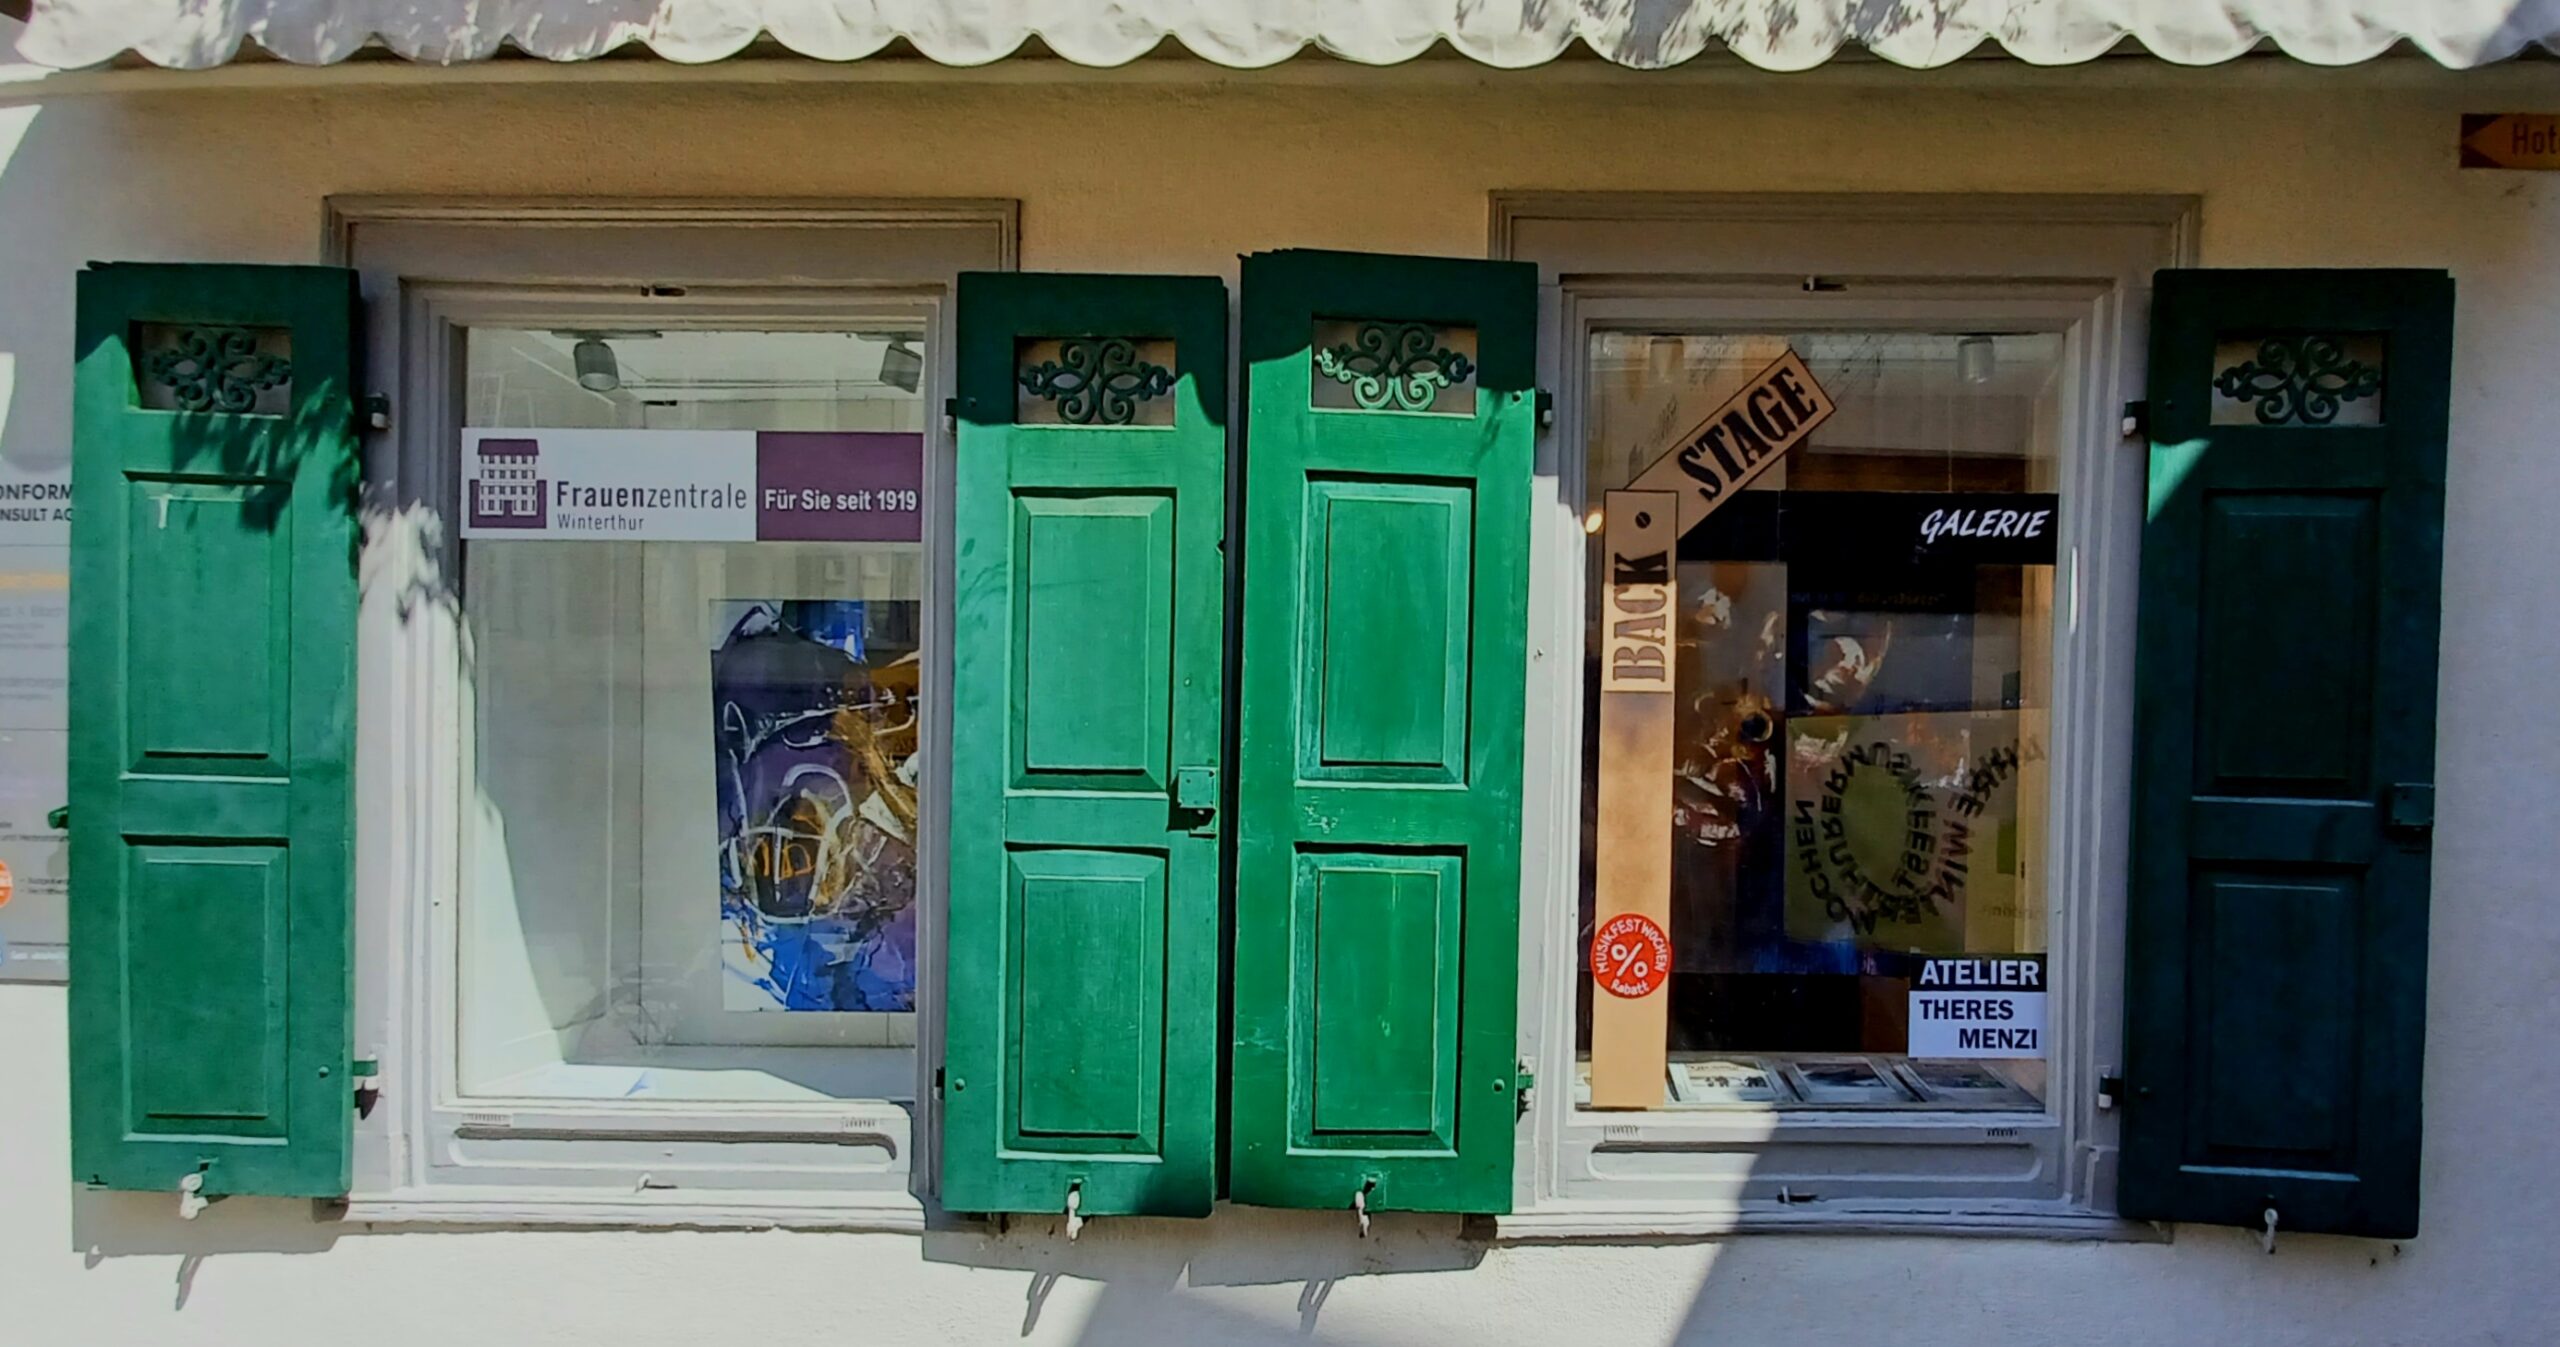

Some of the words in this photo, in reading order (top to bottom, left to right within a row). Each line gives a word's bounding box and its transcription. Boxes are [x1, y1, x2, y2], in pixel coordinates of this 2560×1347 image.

[1677, 366, 1818, 502] STAGE
[557, 481, 747, 509] Frauenzentrale
[765, 488, 797, 510] Für
[801, 488, 832, 511] Sie
[836, 490, 872, 511] seit
[876, 490, 917, 511] 1919
[557, 514, 645, 531] Winterthur
[1920, 508, 2051, 544] GALERIE
[1612, 550, 1668, 682] BACK
[1920, 959, 2040, 985] ATELIER
[1611, 979, 1650, 996] Rabatt
[1919, 999, 2014, 1020] THERES
[1959, 1028, 2037, 1049] MENZI
